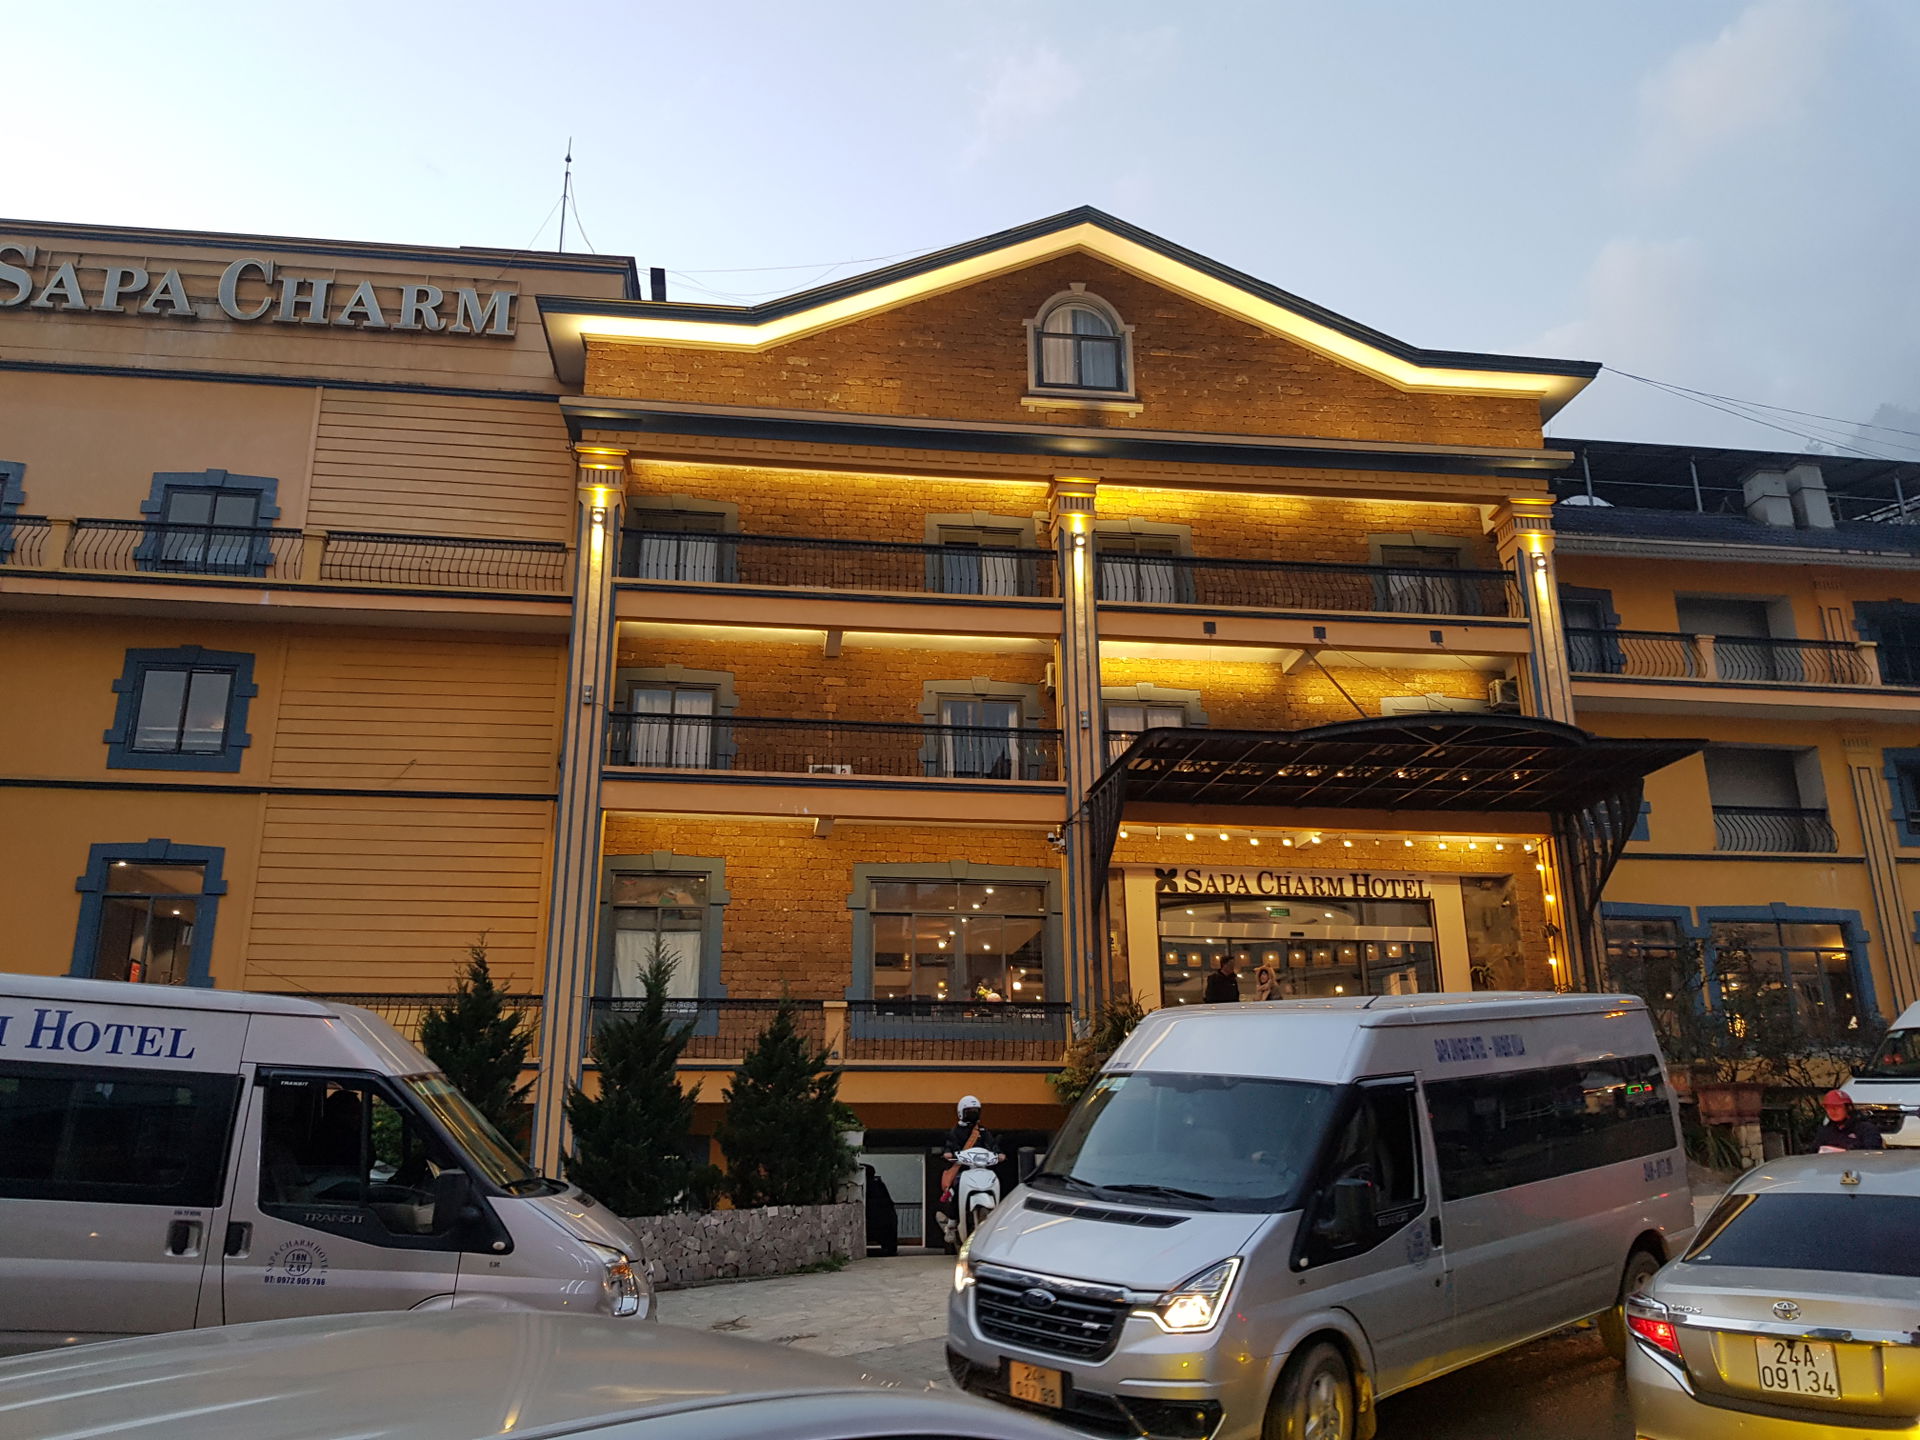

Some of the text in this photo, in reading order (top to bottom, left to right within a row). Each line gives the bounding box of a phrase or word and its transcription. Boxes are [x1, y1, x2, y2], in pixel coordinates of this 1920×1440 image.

[0, 243, 518, 336] SAPA CHARM
[1184, 868, 1431, 899] SAPA CHARM HOTEL
[25, 1008, 195, 1059] HOTEL
[304, 1212, 366, 1224] TRANSIT
[1774, 1342, 1816, 1367] 24A
[1762, 1366, 1836, 1395] 091.34
